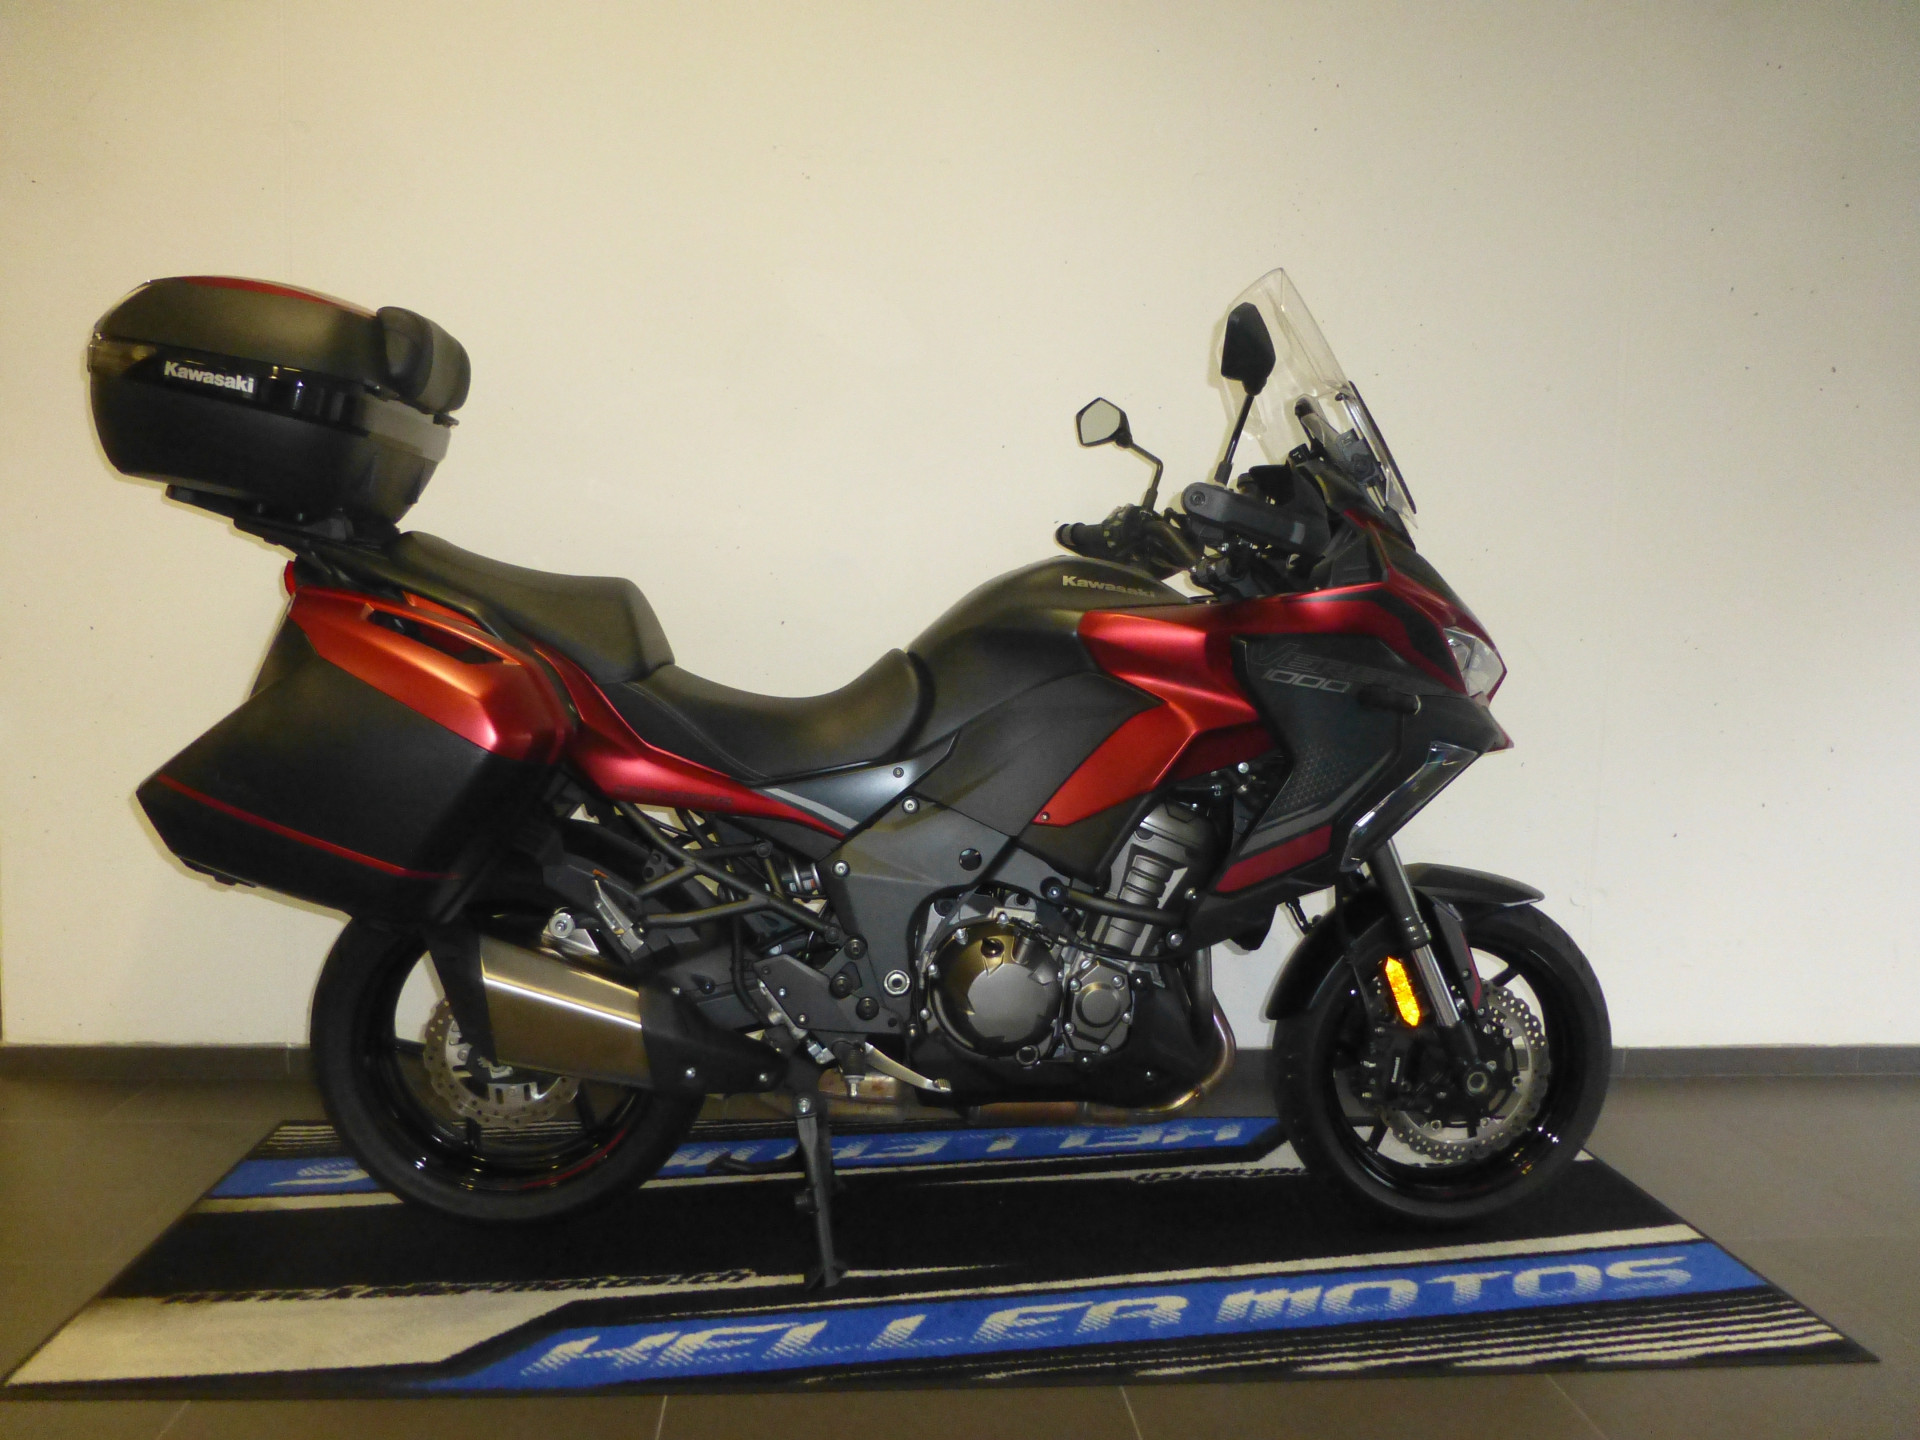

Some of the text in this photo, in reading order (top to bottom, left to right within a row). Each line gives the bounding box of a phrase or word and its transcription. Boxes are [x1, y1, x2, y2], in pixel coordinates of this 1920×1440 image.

[163, 360, 255, 393] Kawasaki
[1062, 575, 1155, 598] Kawasaki
[1262, 668, 1351, 694] 1000
[519, 1255, 1692, 1377] HELLER MOTOS
